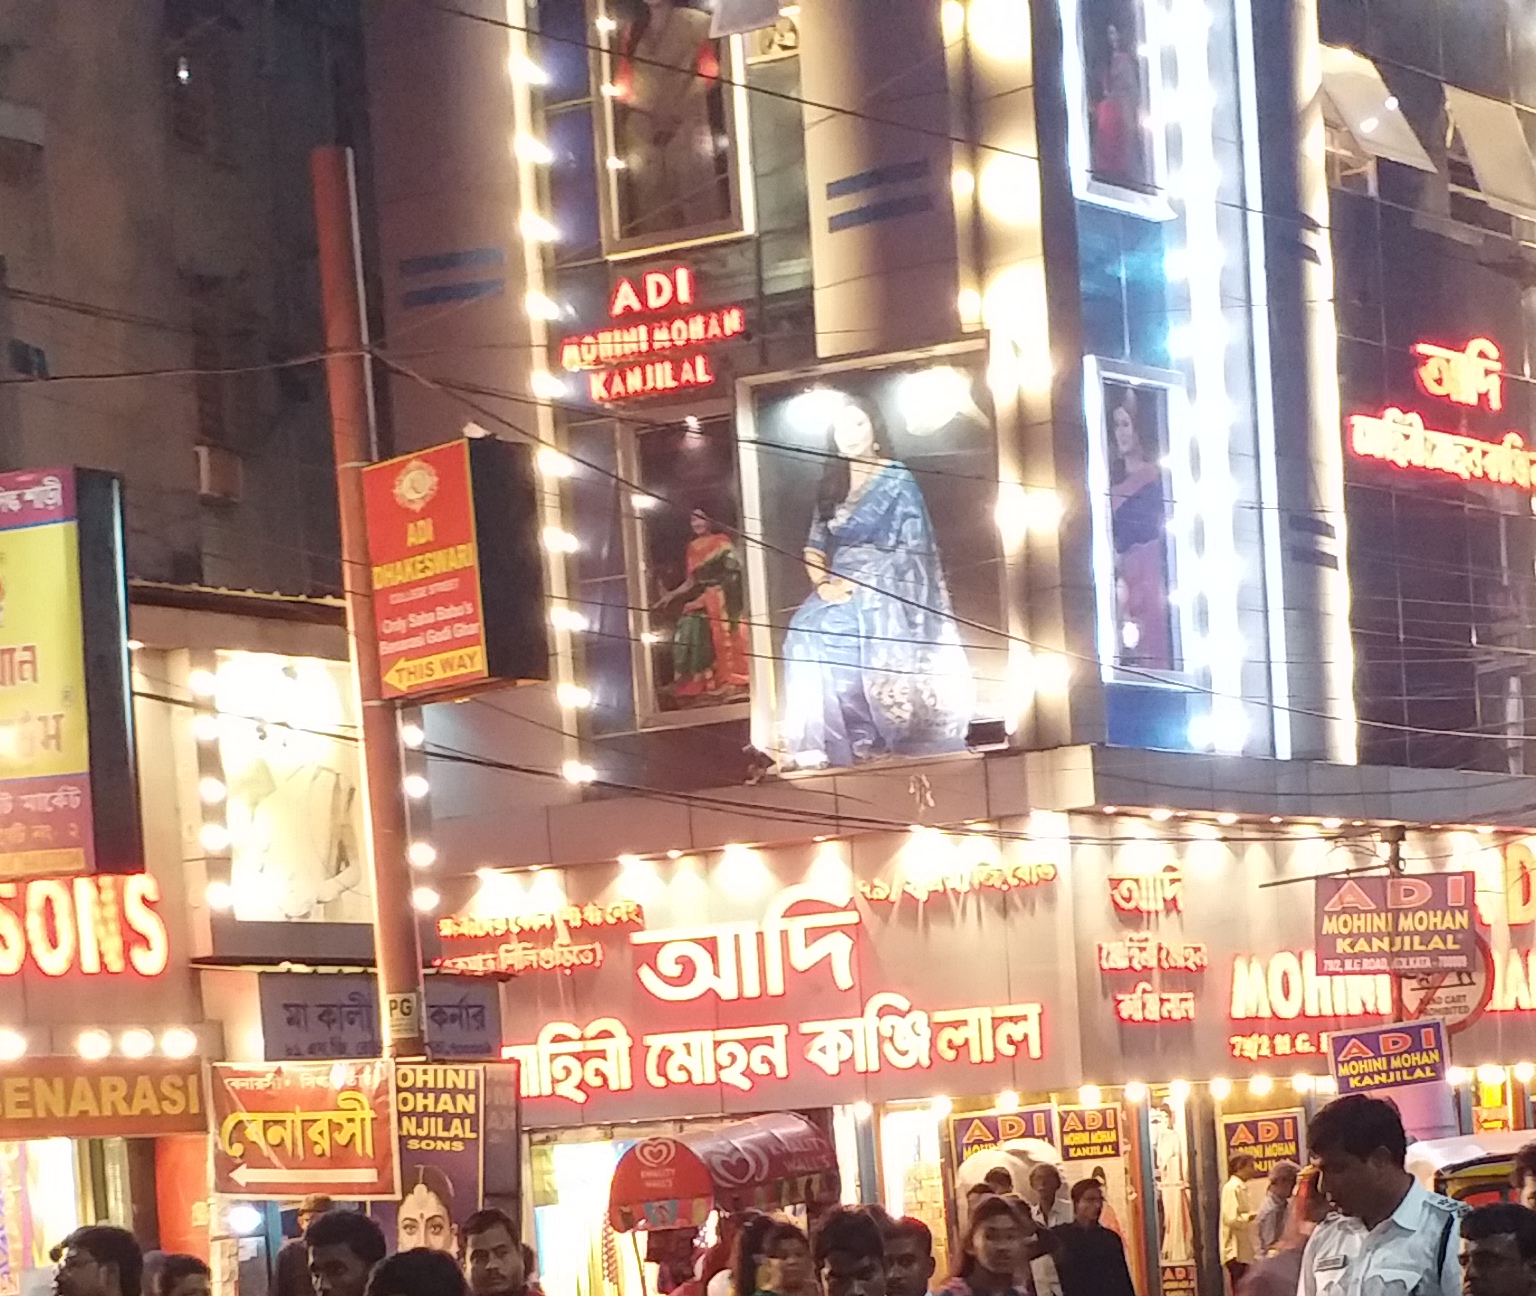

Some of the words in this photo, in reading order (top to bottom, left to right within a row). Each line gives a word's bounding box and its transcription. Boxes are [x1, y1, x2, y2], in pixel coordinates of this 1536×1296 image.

[611, 267, 691, 316] ADI
[590, 355, 712, 401] KANJILAL
[395, 661, 435, 685] THIS
[440, 651, 478, 674] WAY
[1108, 865, 1184, 913] আদি
[1324, 876, 1465, 911] ADI
[1321, 911, 1393, 935] MOHINI
[1398, 910, 1469, 933] MOHAN
[629, 882, 860, 1001] আদি
[1336, 933, 1461, 954] KANJILAL
[283, 1001, 309, 1031] মা
[388, 998, 413, 1017] PG
[643, 1024, 789, 1091] মোহন
[1338, 1027, 1435, 1062] ADI
[1337, 1057, 1388, 1077] MOHINI
[1390, 1048, 1441, 1071] MOHAN
[1348, 1064, 1437, 1089] KANJILAL
[396, 1068, 476, 1091] OHINI
[396, 1092, 477, 1115] OHAN
[221, 1090, 379, 1161] বেনারসী
[963, 1112, 1047, 1144] ADI
[1062, 1109, 1116, 1132] ADI
[1230, 1119, 1295, 1147] ADI
[406, 1139, 465, 1153] SONS
[1068, 1145, 1116, 1158] KANJILAL
